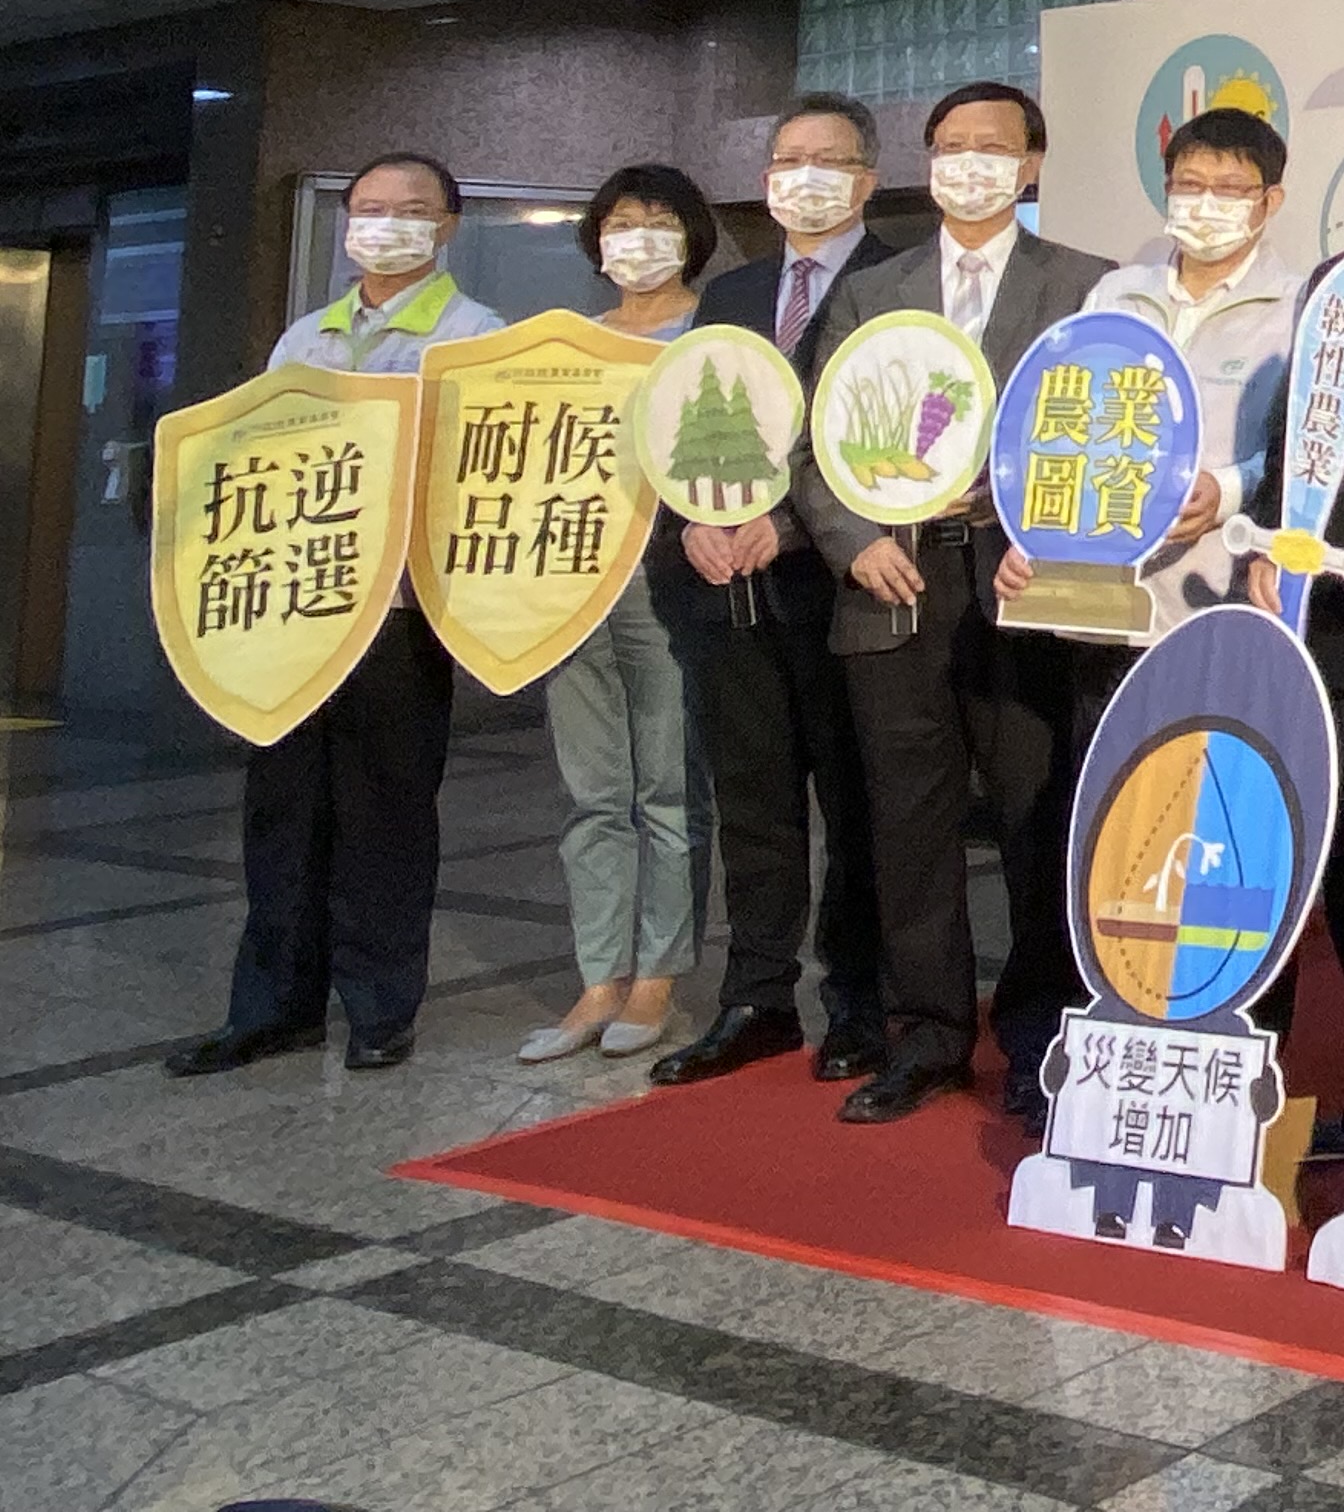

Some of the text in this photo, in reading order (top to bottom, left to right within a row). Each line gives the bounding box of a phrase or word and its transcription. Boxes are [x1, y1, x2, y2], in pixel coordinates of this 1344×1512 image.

[457, 401, 620, 484] 耐候
[1030, 363, 1167, 448] 農業
[203, 442, 365, 544] 抗逆
[445, 493, 608, 577] 品種
[1021, 451, 1154, 540] 圖資
[197, 531, 360, 638] 篩選
[1076, 1032, 1243, 1107] 災變天候
[1109, 1099, 1192, 1164] 增加
